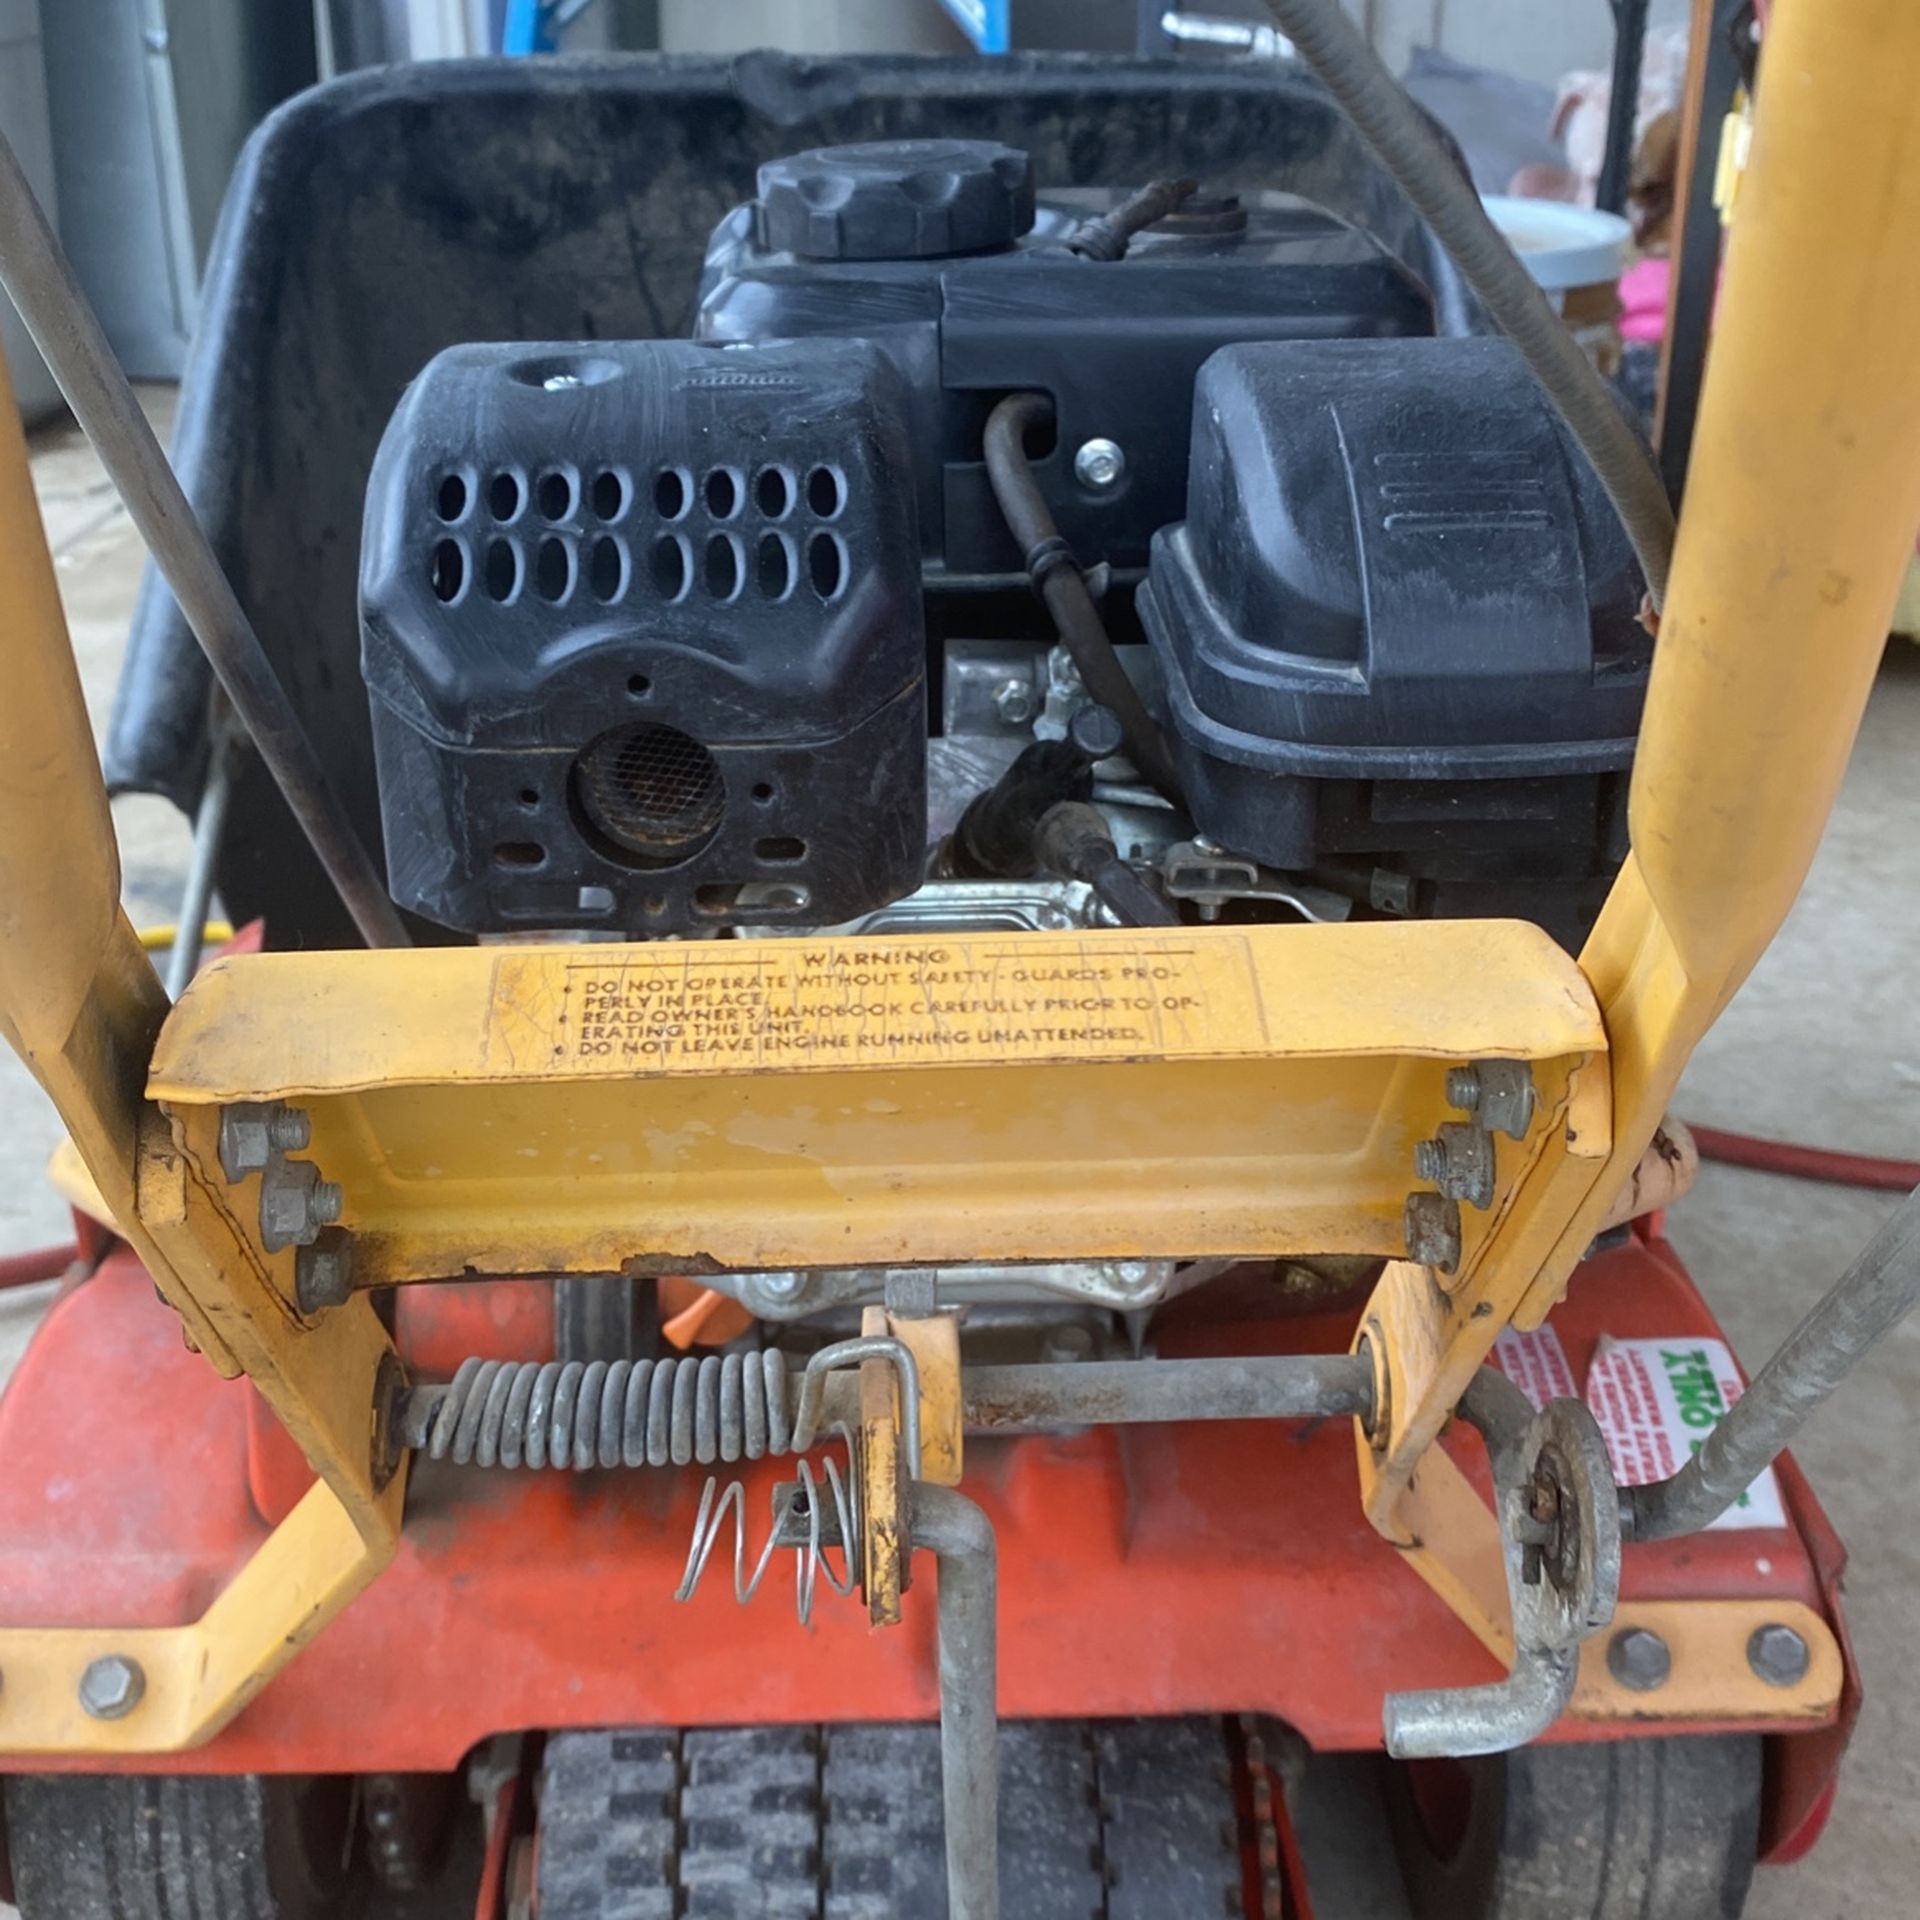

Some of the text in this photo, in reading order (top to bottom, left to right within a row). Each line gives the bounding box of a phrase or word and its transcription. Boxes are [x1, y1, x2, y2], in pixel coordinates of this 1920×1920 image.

[803, 950, 950, 967] WARNING
[585, 981, 617, 994] DO
[628, 978, 678, 993] NOT
[686, 975, 787, 991] OPERATE
[799, 972, 899, 988] WITHOUT
[1121, 967, 1181, 980] PRO-
[582, 1011, 643, 1024] READ
[768, 1003, 901, 1018] HANDBOOK
[909, 999, 1036, 1015] CAREFULLY
[1044, 998, 1115, 1011] PRIOR
[1120, 997, 1150, 1010] TO
[1163, 996, 1200, 1010] OP-
[584, 996, 651, 1009] PERLY
[659, 994, 685, 1008] IN
[581, 1020, 810, 1040] ERATING THIS UNIT.
[579, 1028, 1145, 1056] DO NOT LEAVE ENGINE RUNNING UNATTENDED.
